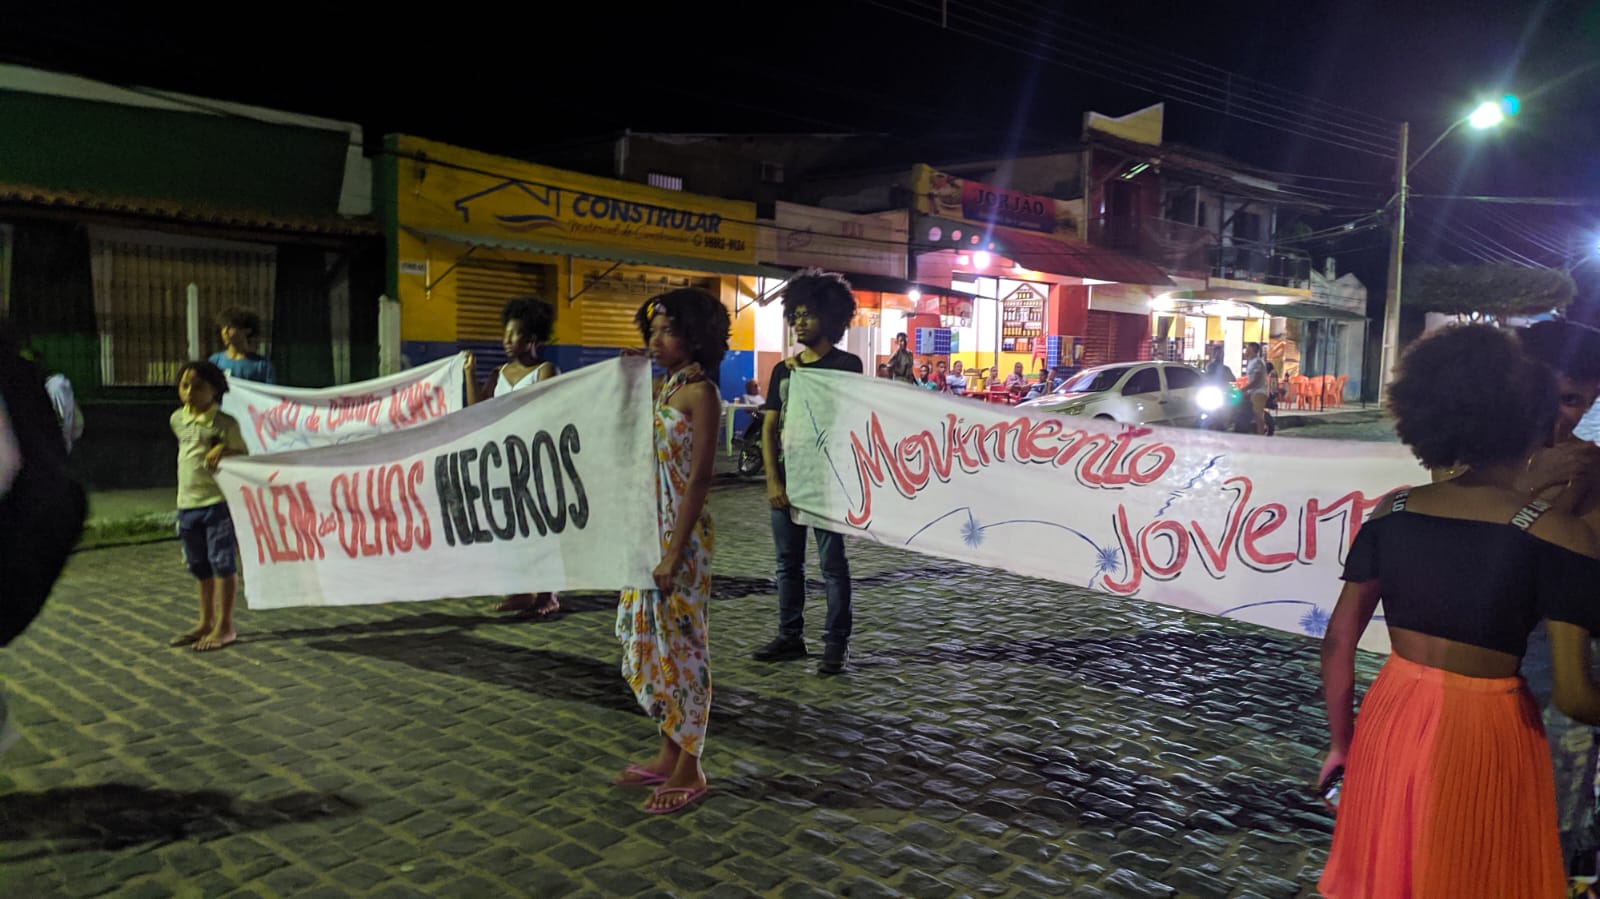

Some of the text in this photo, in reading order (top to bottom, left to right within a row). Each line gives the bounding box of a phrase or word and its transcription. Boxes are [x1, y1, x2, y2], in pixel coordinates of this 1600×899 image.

[572, 193, 721, 234] CONSTRULAR
[304, 405, 321, 432] de
[846, 410, 1175, 529] Movimento
[240, 469, 326, 565] ALÉM
[330, 459, 433, 559] OLHOS
[434, 423, 590, 548] NEGROS
[1511, 507, 1540, 531] OVE
